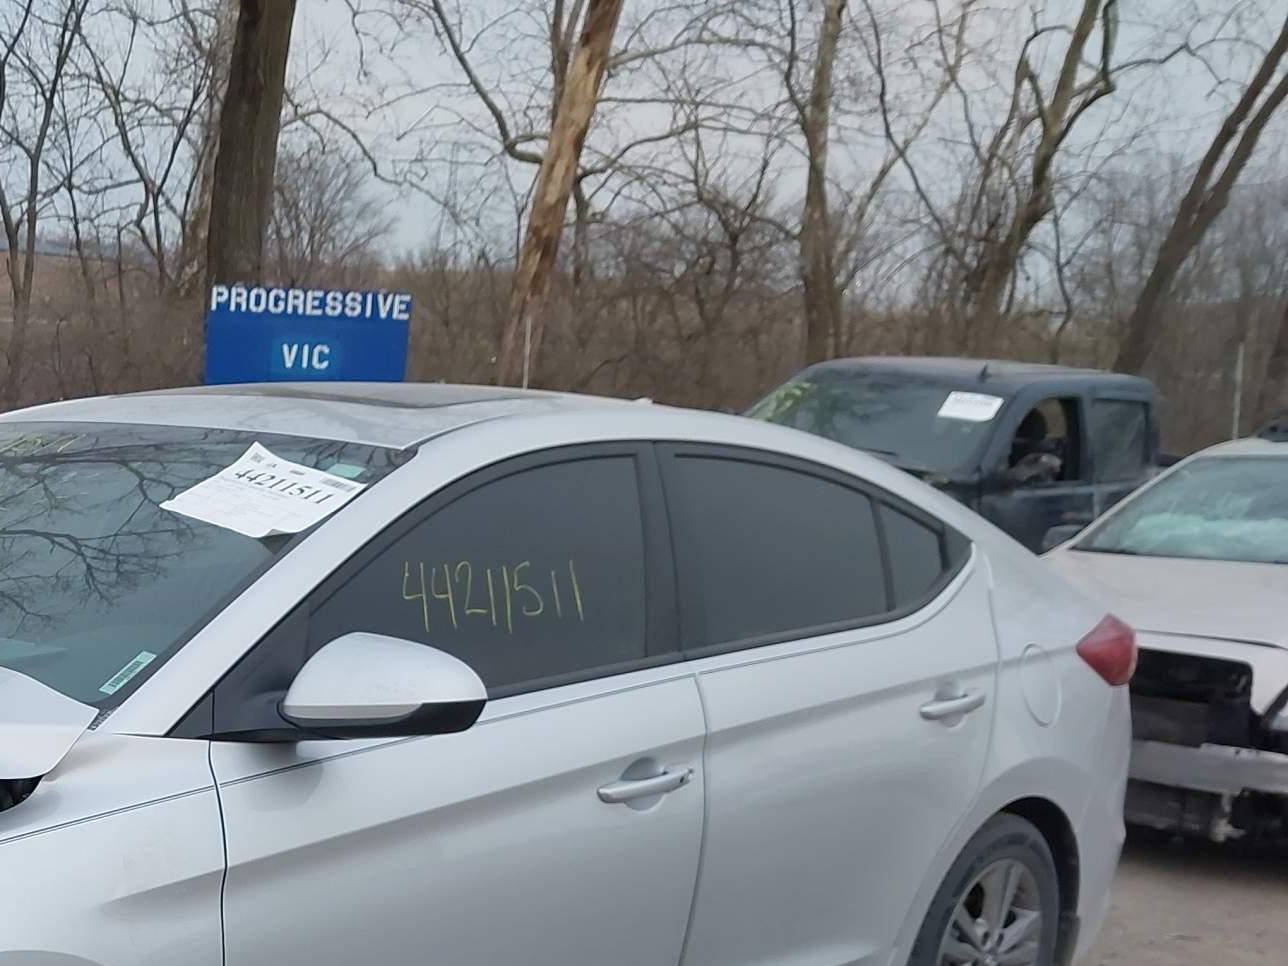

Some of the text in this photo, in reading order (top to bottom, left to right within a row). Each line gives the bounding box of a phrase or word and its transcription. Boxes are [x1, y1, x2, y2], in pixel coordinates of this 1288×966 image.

[210, 285, 412, 320] PROGRESSIVE
[282, 343, 330, 370] VIC
[235, 469, 334, 504] 44211511
[402, 560, 584, 634] 44211511
